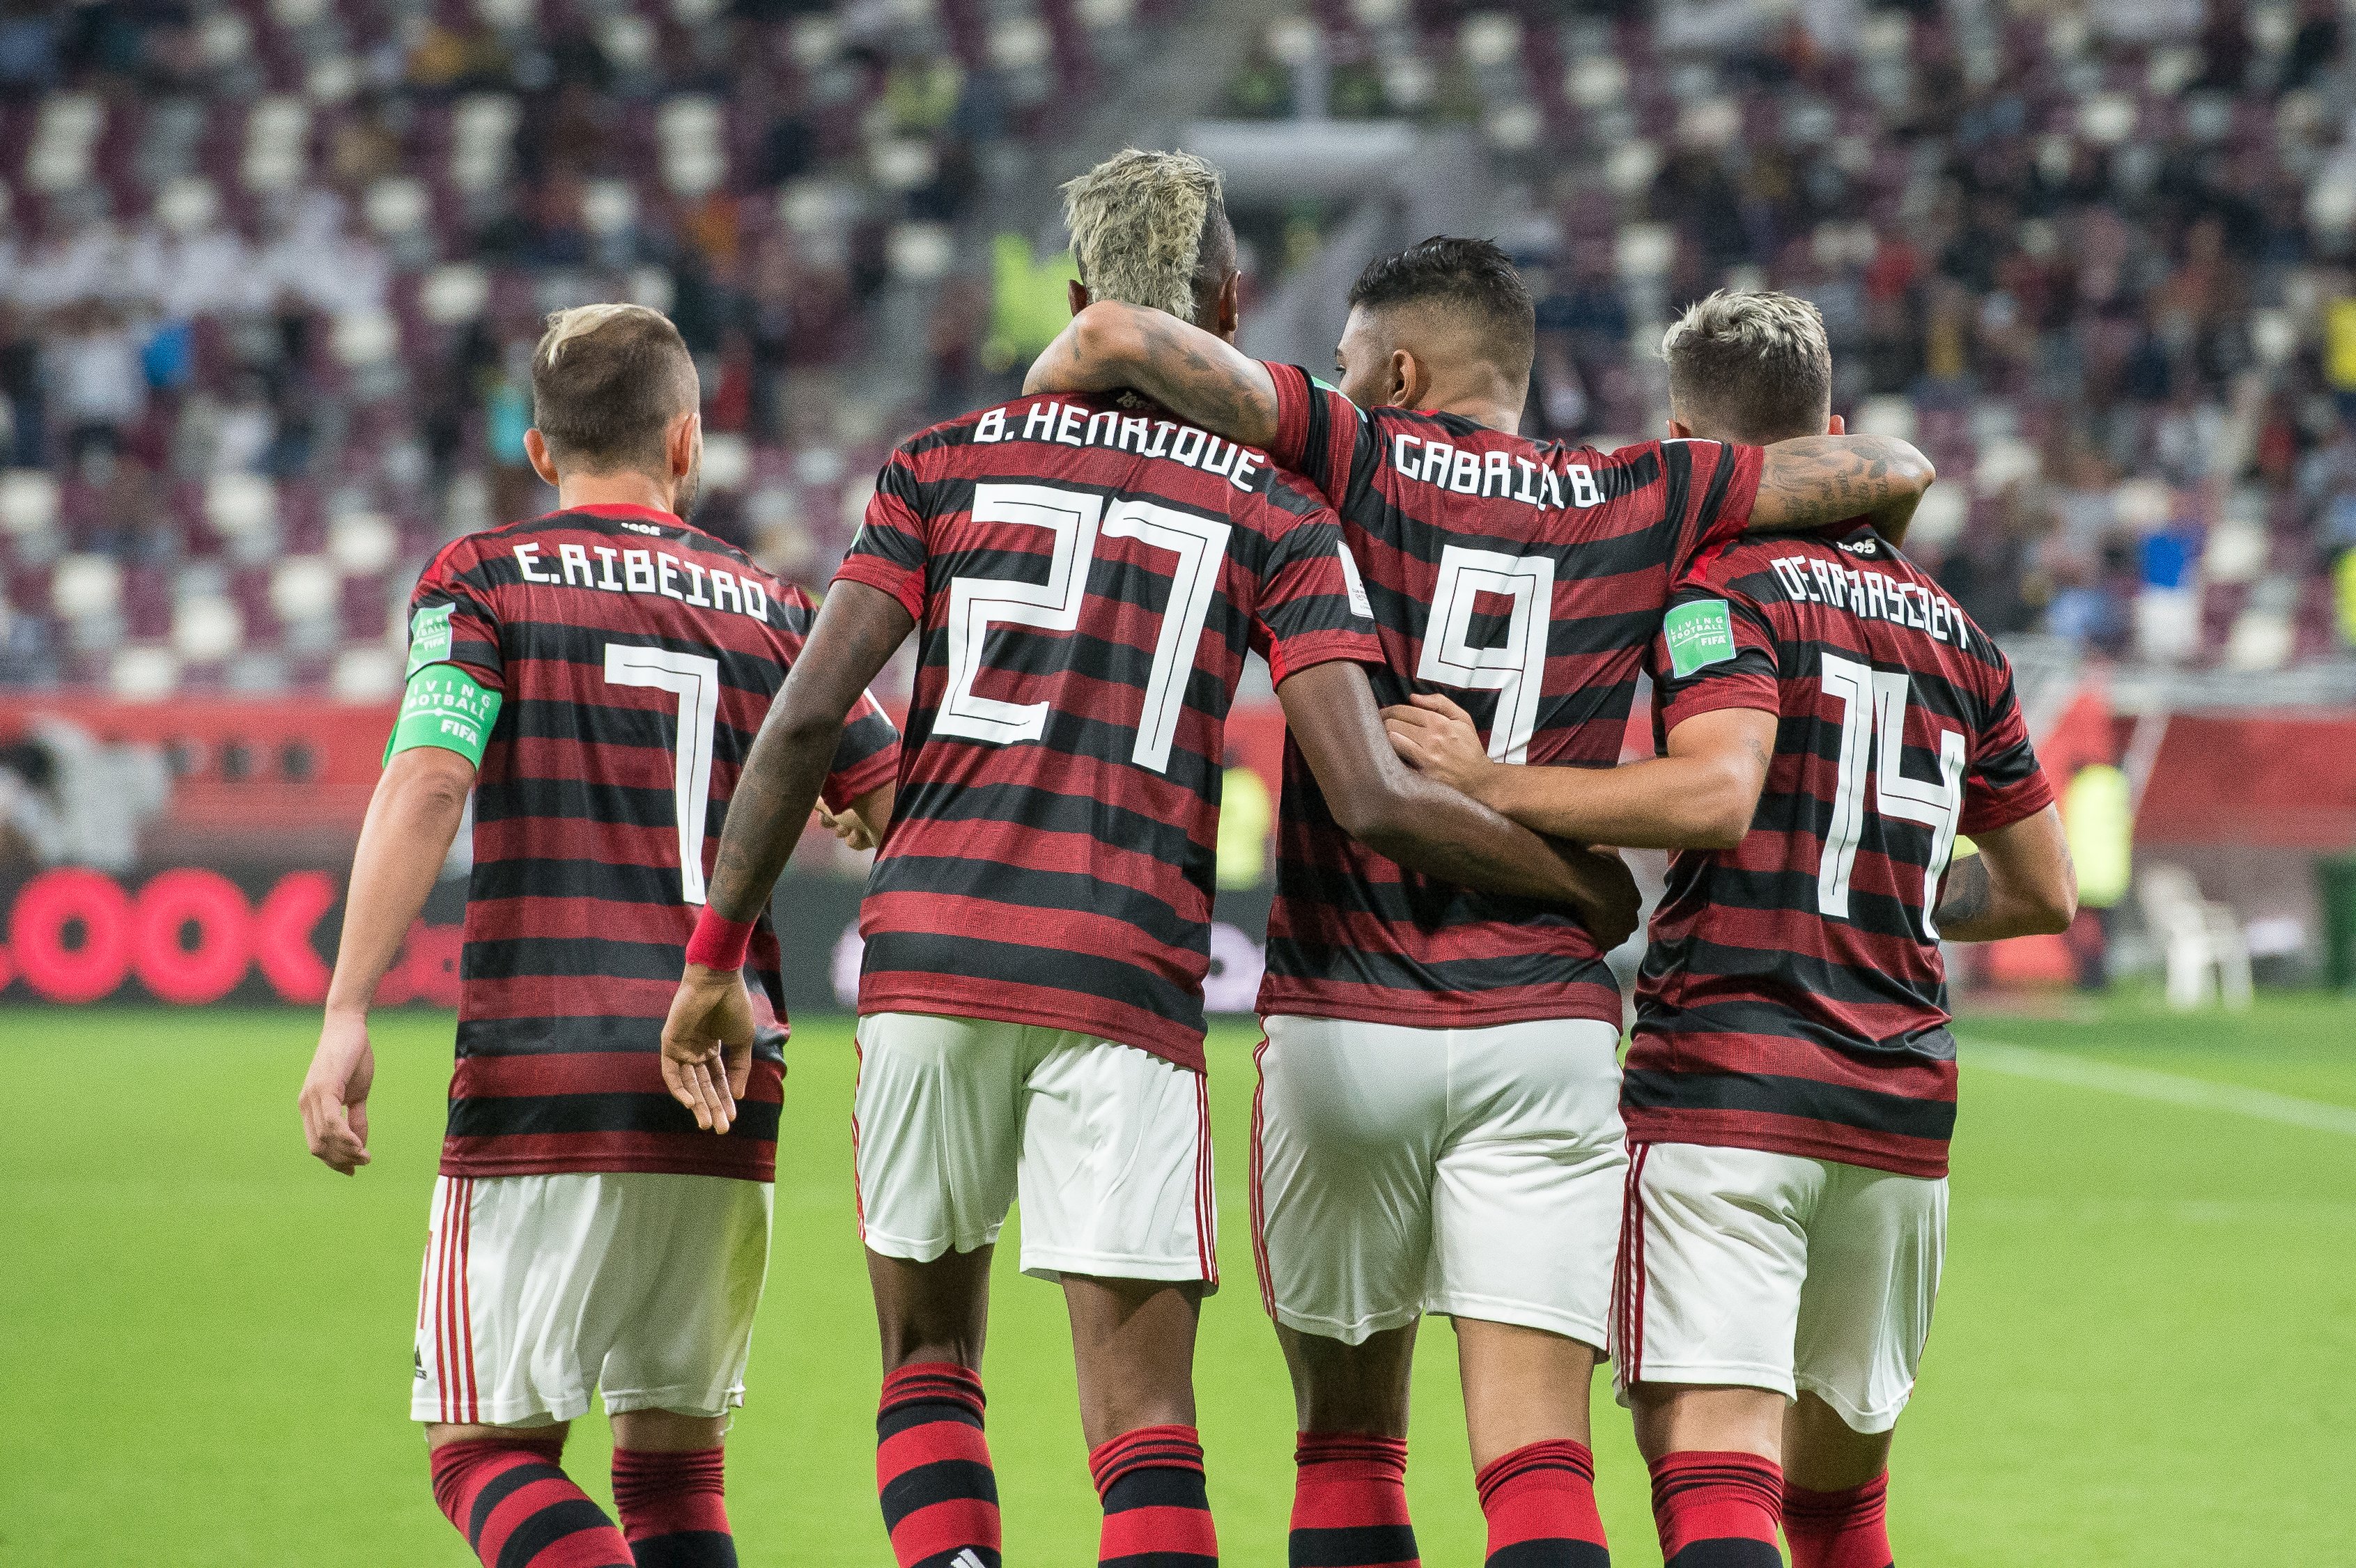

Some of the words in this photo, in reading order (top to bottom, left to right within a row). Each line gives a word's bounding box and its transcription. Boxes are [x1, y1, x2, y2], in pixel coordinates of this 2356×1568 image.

[513, 542, 768, 622] E.RIBEIRO
[932, 483, 1232, 774] 27
[1670, 616, 1723, 635] LIVING
[1671, 624, 1724, 643] FOOTBALL
[1700, 634, 1727, 646] FIFA
[1417, 544, 1555, 765] 9
[408, 693, 485, 722] OOTBALL
[414, 680, 490, 708] IVING
[440, 719, 478, 747] FIFA
[604, 643, 718, 905] 7
[1818, 652, 1965, 940] 14
